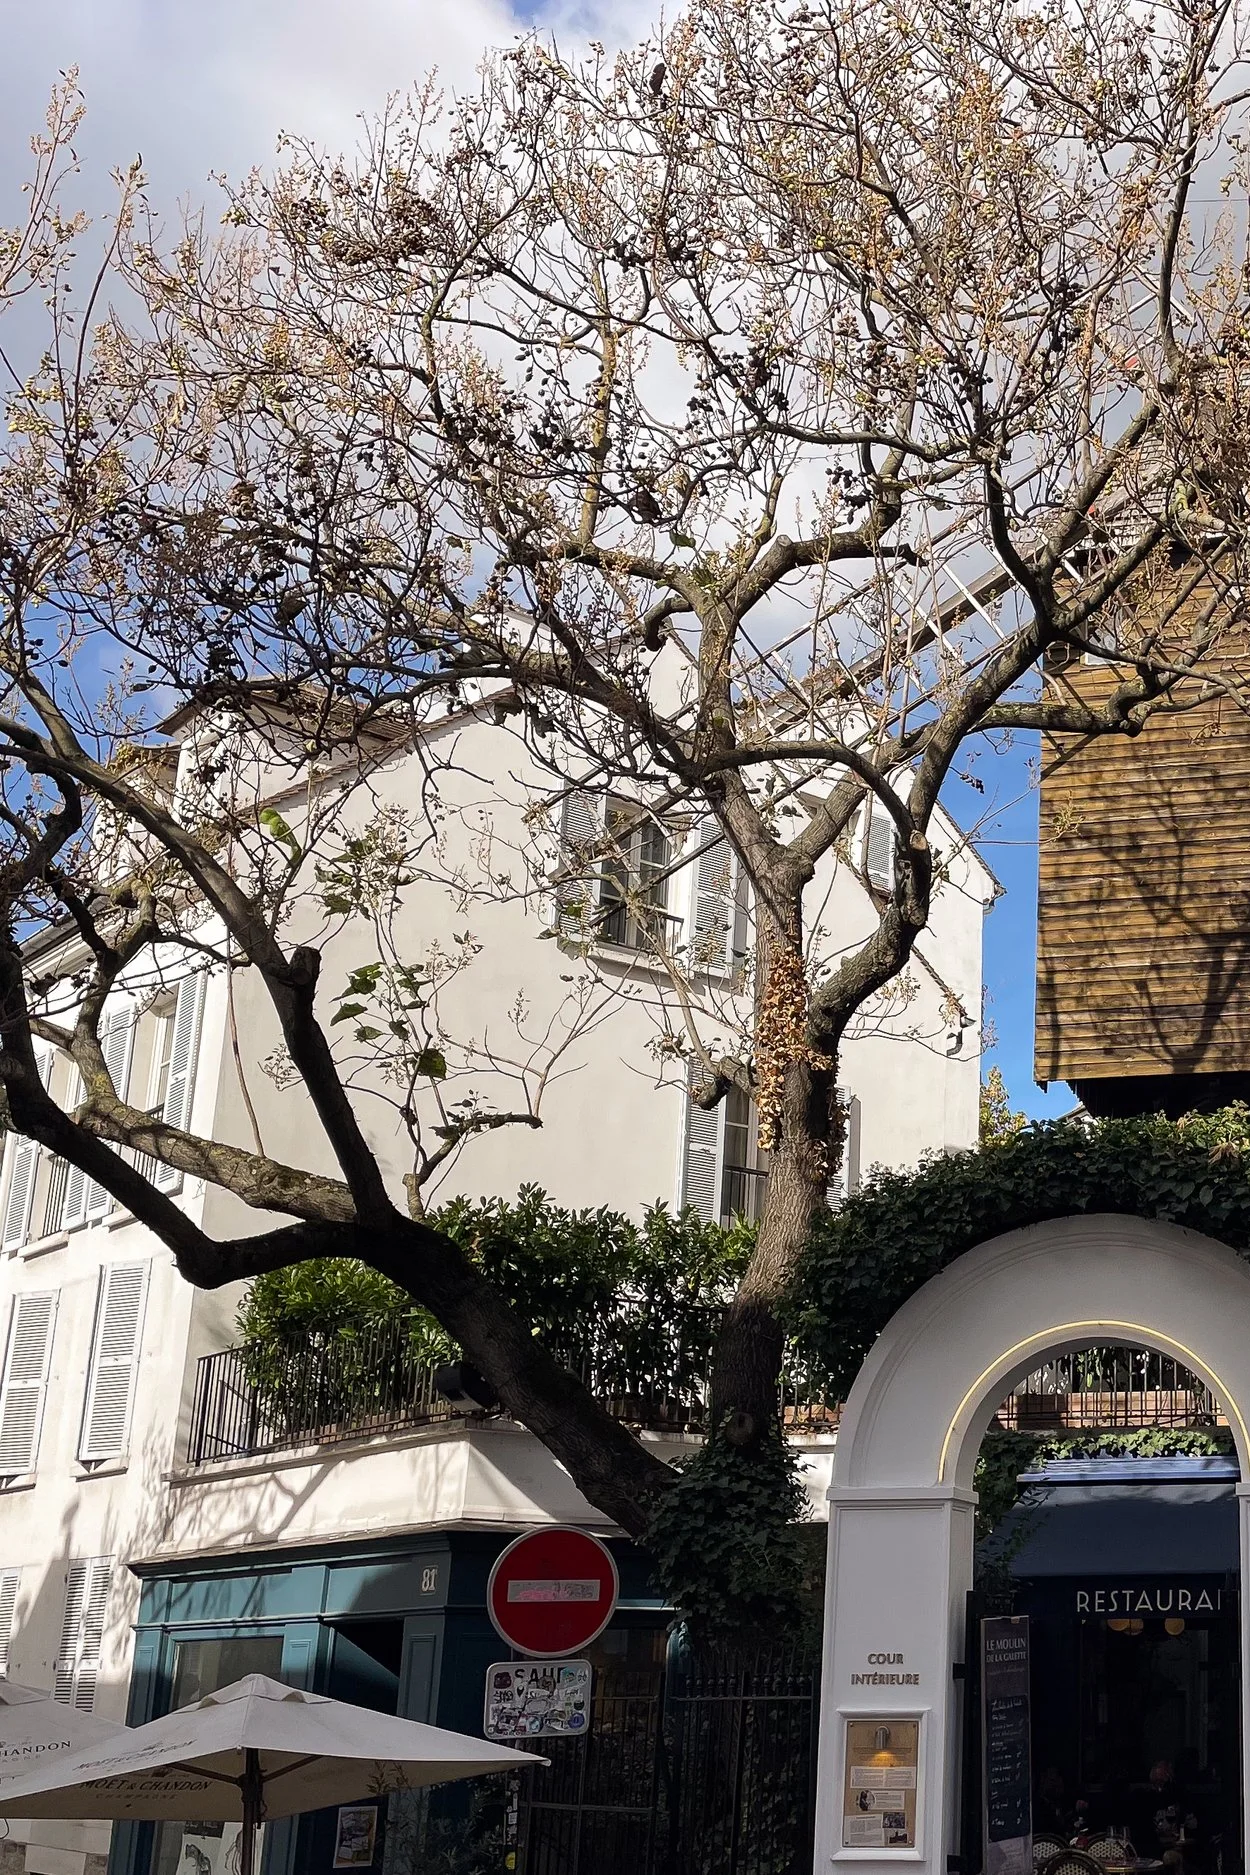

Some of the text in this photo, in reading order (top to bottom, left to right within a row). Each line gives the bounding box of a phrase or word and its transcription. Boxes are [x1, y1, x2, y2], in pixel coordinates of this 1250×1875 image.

[421, 1568, 437, 1592] 81
[1076, 1588, 1221, 1613] RESTAURA
[986, 1637, 1027, 1651] LE MOULIN
[867, 1652, 904, 1665] COUR
[850, 1671, 920, 1686] INTÉRIEURE
[0, 1740, 72, 1757] HANDON
[139, 1780, 213, 1791] CHANDON
